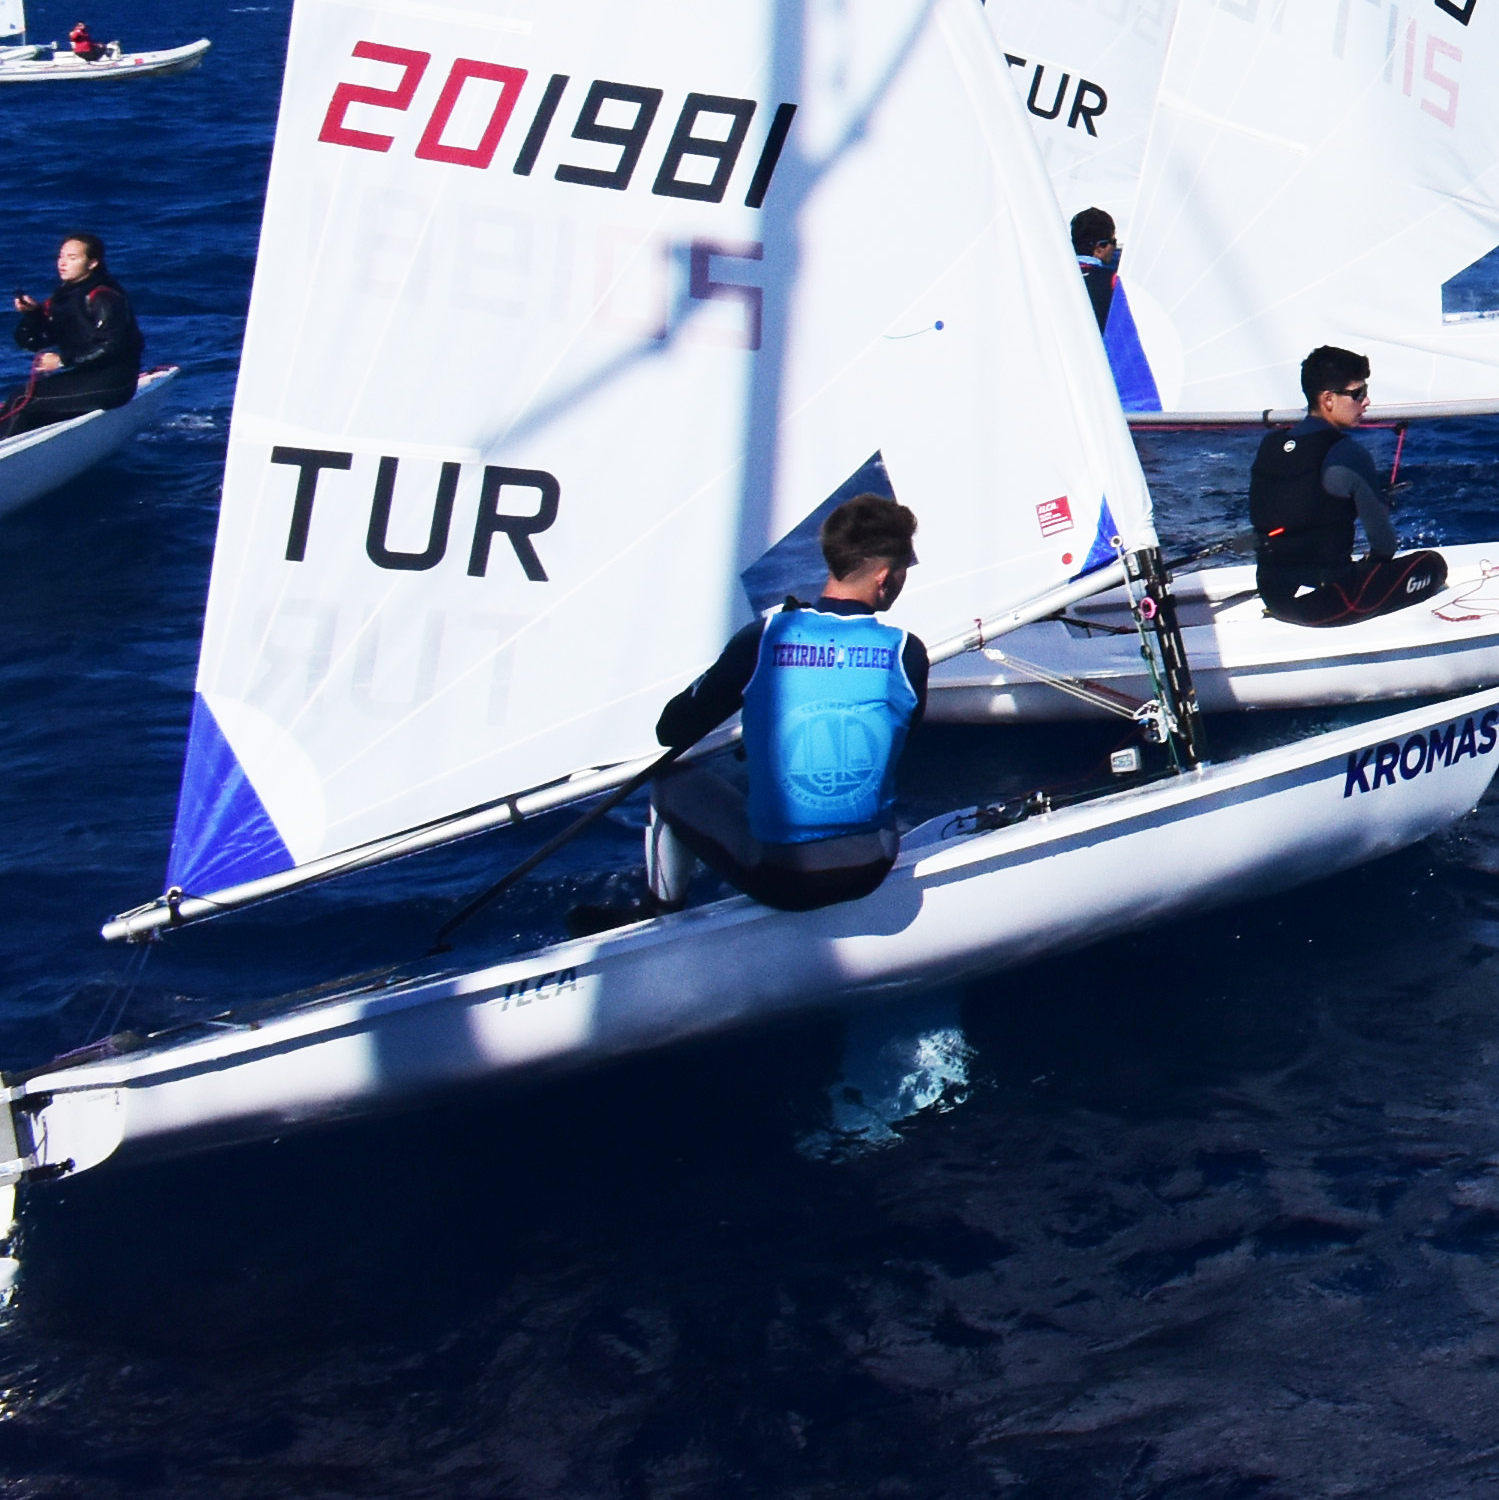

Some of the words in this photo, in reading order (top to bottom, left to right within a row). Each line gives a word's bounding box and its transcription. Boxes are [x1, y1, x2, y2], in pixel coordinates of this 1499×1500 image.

[317, 40, 799, 209] 201981
[269, 445, 562, 583] TUR
[1343, 709, 1499, 799] KROMAS
[500, 965, 577, 1012] ILCA
